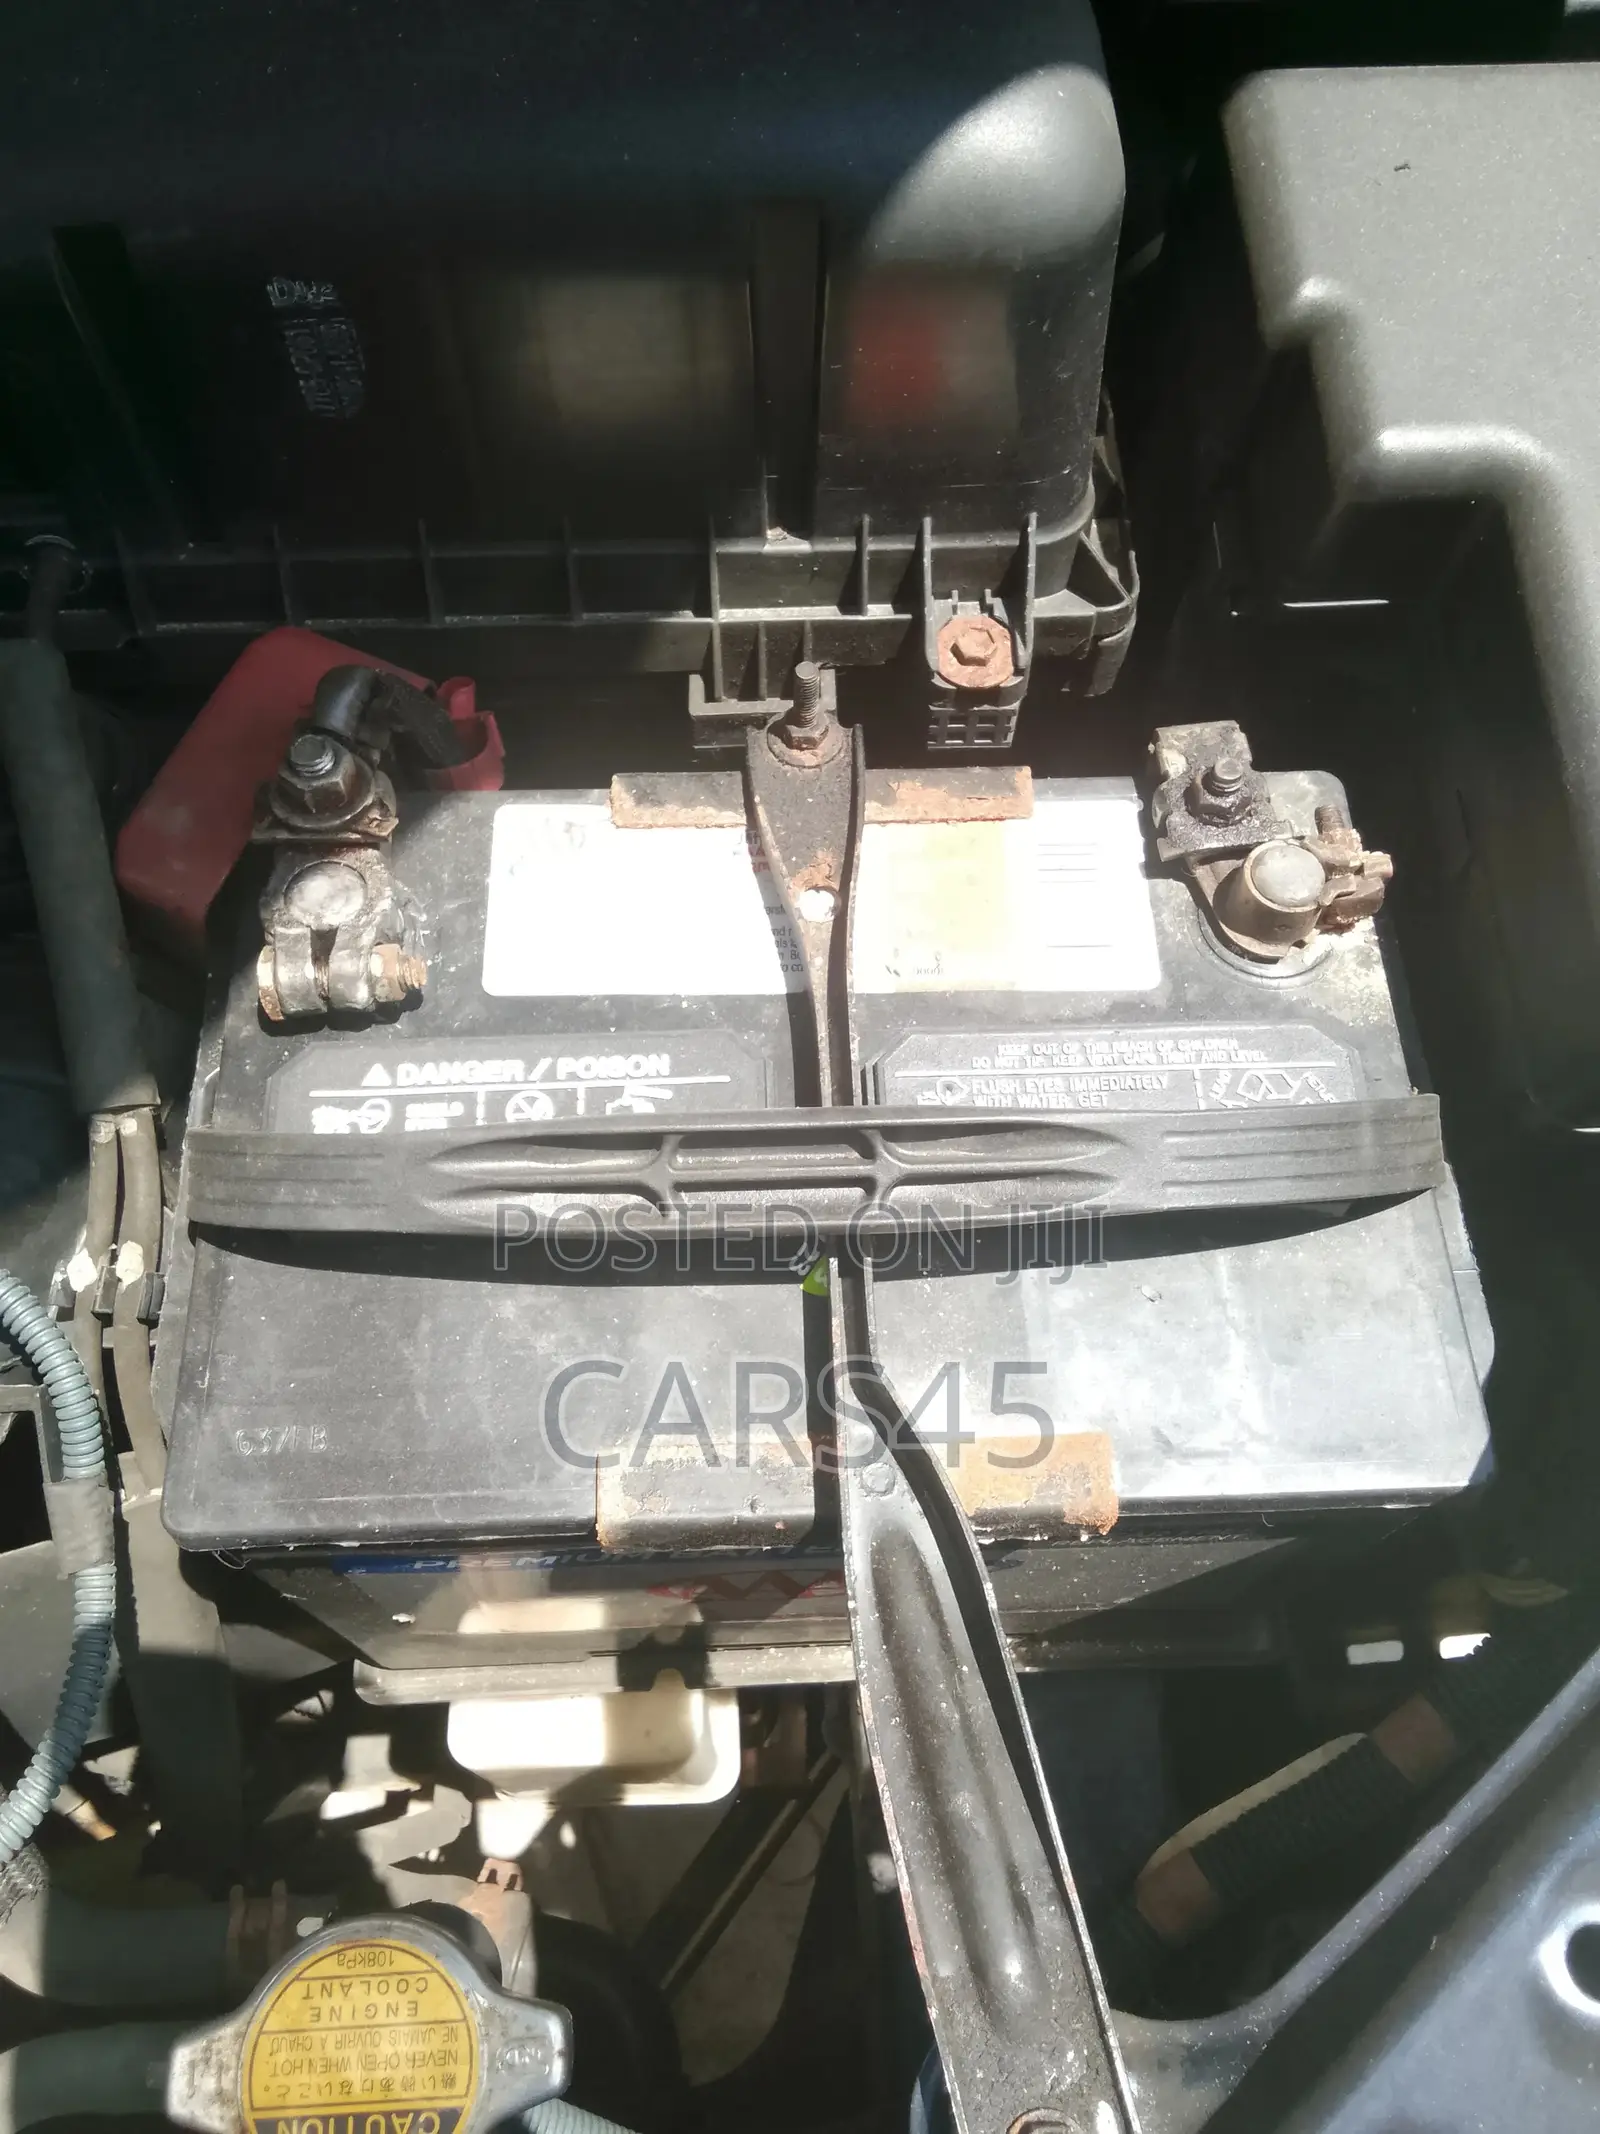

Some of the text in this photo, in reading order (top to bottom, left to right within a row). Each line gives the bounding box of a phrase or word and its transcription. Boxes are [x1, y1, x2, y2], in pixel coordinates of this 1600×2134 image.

[1033, 1043, 1060, 1056] OUT
[1156, 1040, 1174, 1052] OF
[396, 1060, 525, 1086] DANGER
[556, 1053, 670, 1080] POISON
[972, 1056, 991, 1069] DO
[995, 1055, 1020, 1068] NOT
[1052, 1054, 1084, 1067] KEEP
[1201, 1050, 1226, 1063] AND
[972, 1075, 1168, 1094] FLUSH EYES IMMEDIATELY
[973, 1094, 1013, 1107] WITH
[1078, 1092, 1110, 1108] GET
[336, 1950, 395, 1970] 108kPa
[301, 1976, 429, 2000] COOLANT
[308, 2000, 418, 2023] ENGINE
[334, 2030, 382, 2050] OUVRIR
[389, 2027, 436, 2048] JAMAIS
[442, 2026, 458, 2043] NE
[308, 2056, 351, 2075] WHEN
[357, 2052, 400, 2071] OPEN
[405, 2049, 458, 2069] NEVER
[277, 2110, 441, 2134] CAUTION
